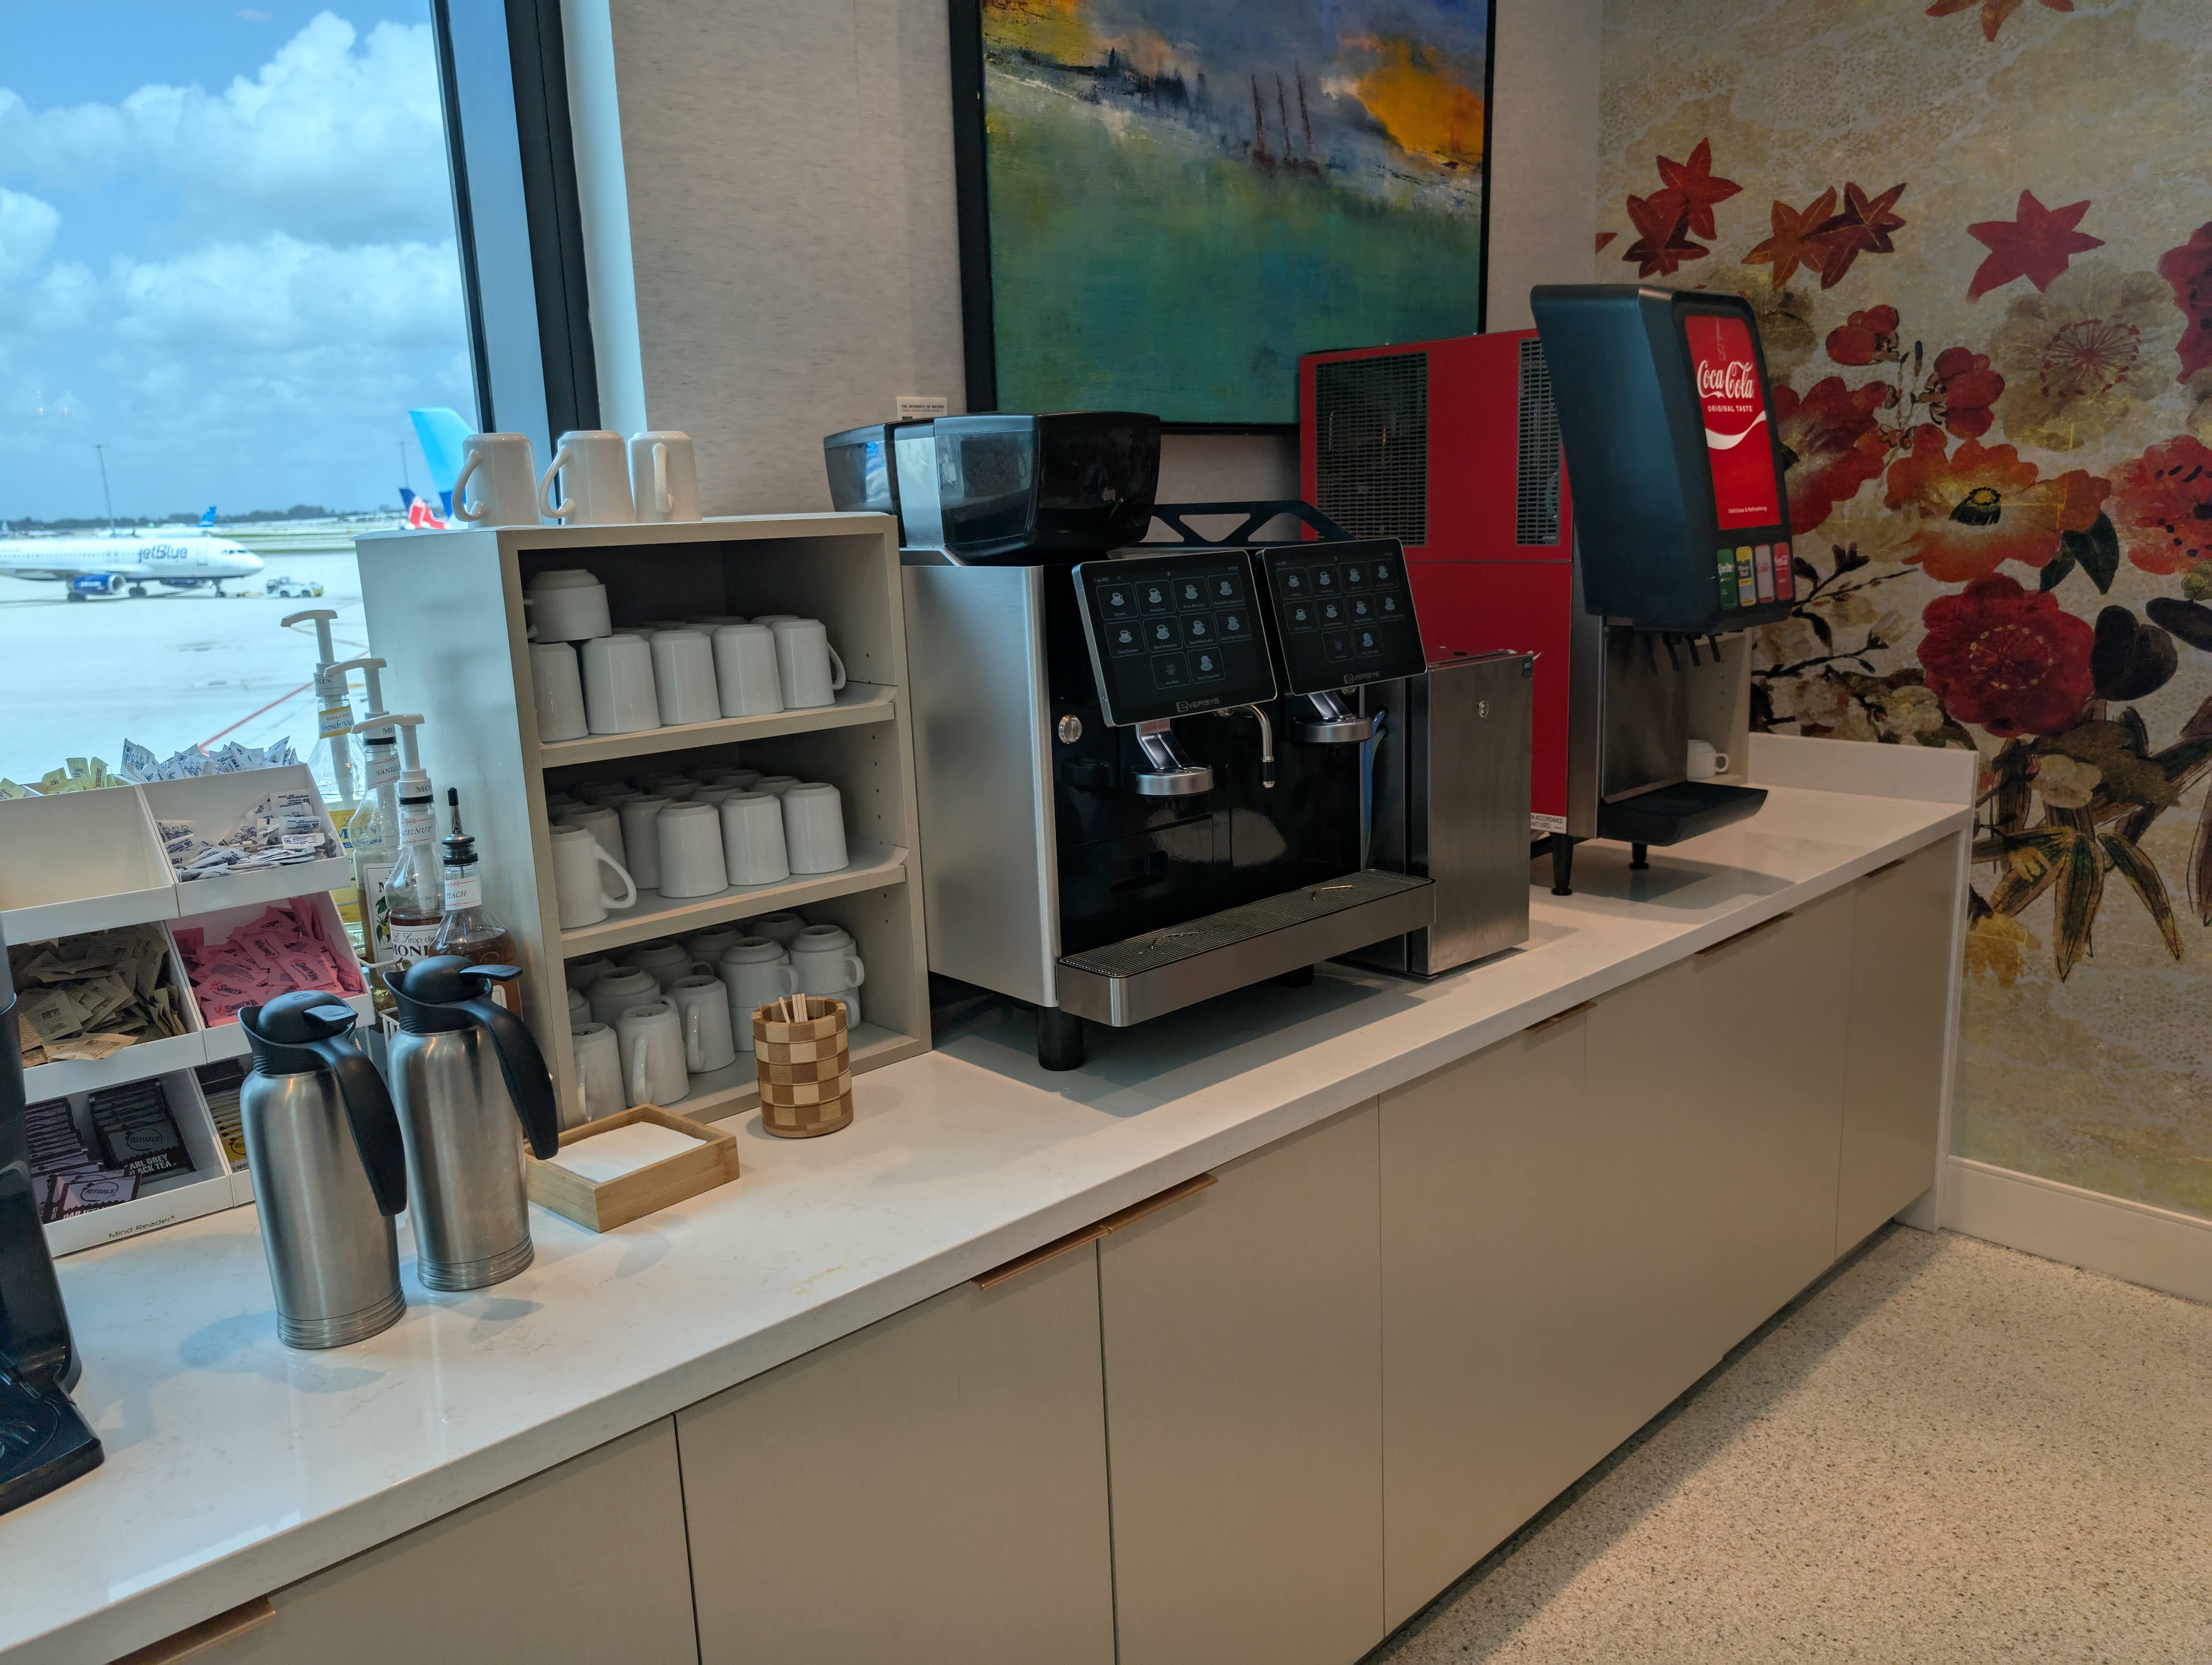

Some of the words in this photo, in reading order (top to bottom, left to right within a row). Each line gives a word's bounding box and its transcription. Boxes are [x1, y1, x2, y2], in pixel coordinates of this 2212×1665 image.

[139, 544, 188, 563] jetBlue
[322, 719, 341, 734] French
[376, 764, 400, 776] VANILL
[1535, 815, 1563, 824] ACCORDANCE
[446, 891, 466, 899] PEACH
[401, 932, 422, 944] Sirop
[146, 1153, 168, 1165] GREY
[154, 1160, 172, 1170] TEA
[109, 1227, 132, 1238] Mind
